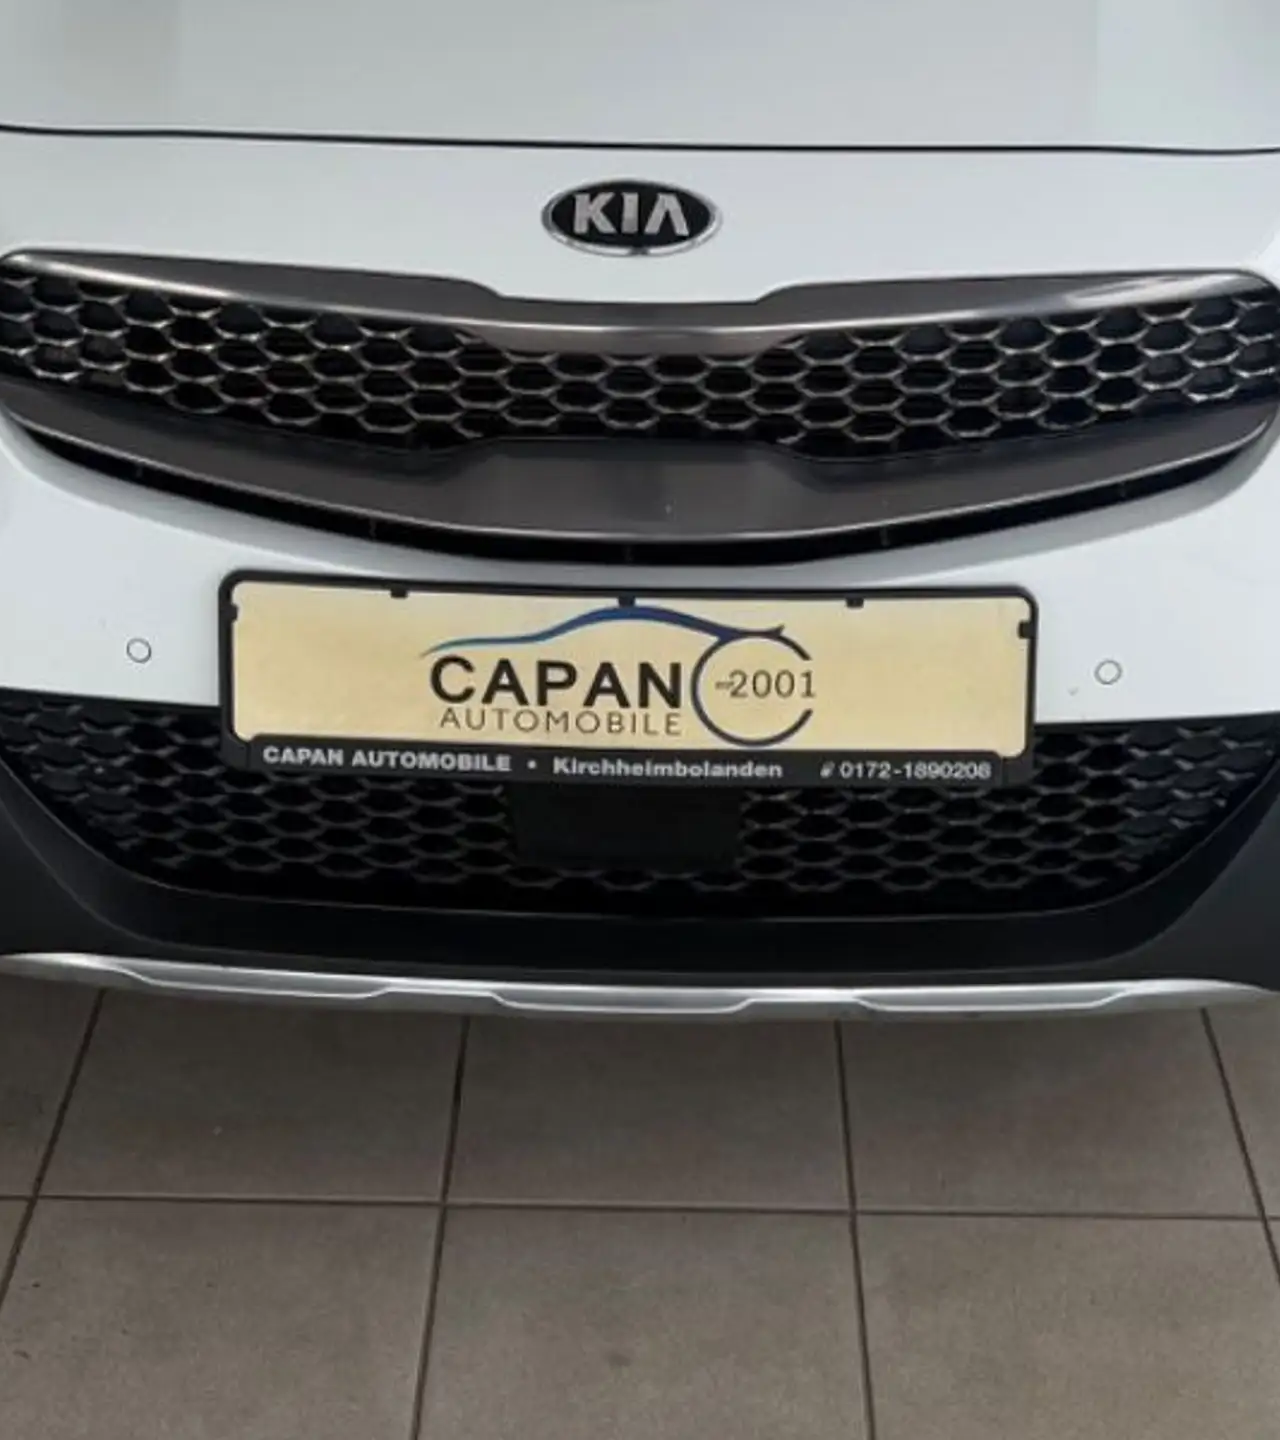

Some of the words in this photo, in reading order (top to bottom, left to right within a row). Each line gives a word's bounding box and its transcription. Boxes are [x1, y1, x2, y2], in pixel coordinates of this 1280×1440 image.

[572, 191, 690, 237] KIA
[429, 654, 682, 710] CAPAN
[439, 707, 683, 737] AUTOMOBILE
[262, 745, 345, 766] CAPAN
[351, 748, 512, 773] AUTOMOBILE
[552, 756, 783, 779] Kirchheimbolanden
